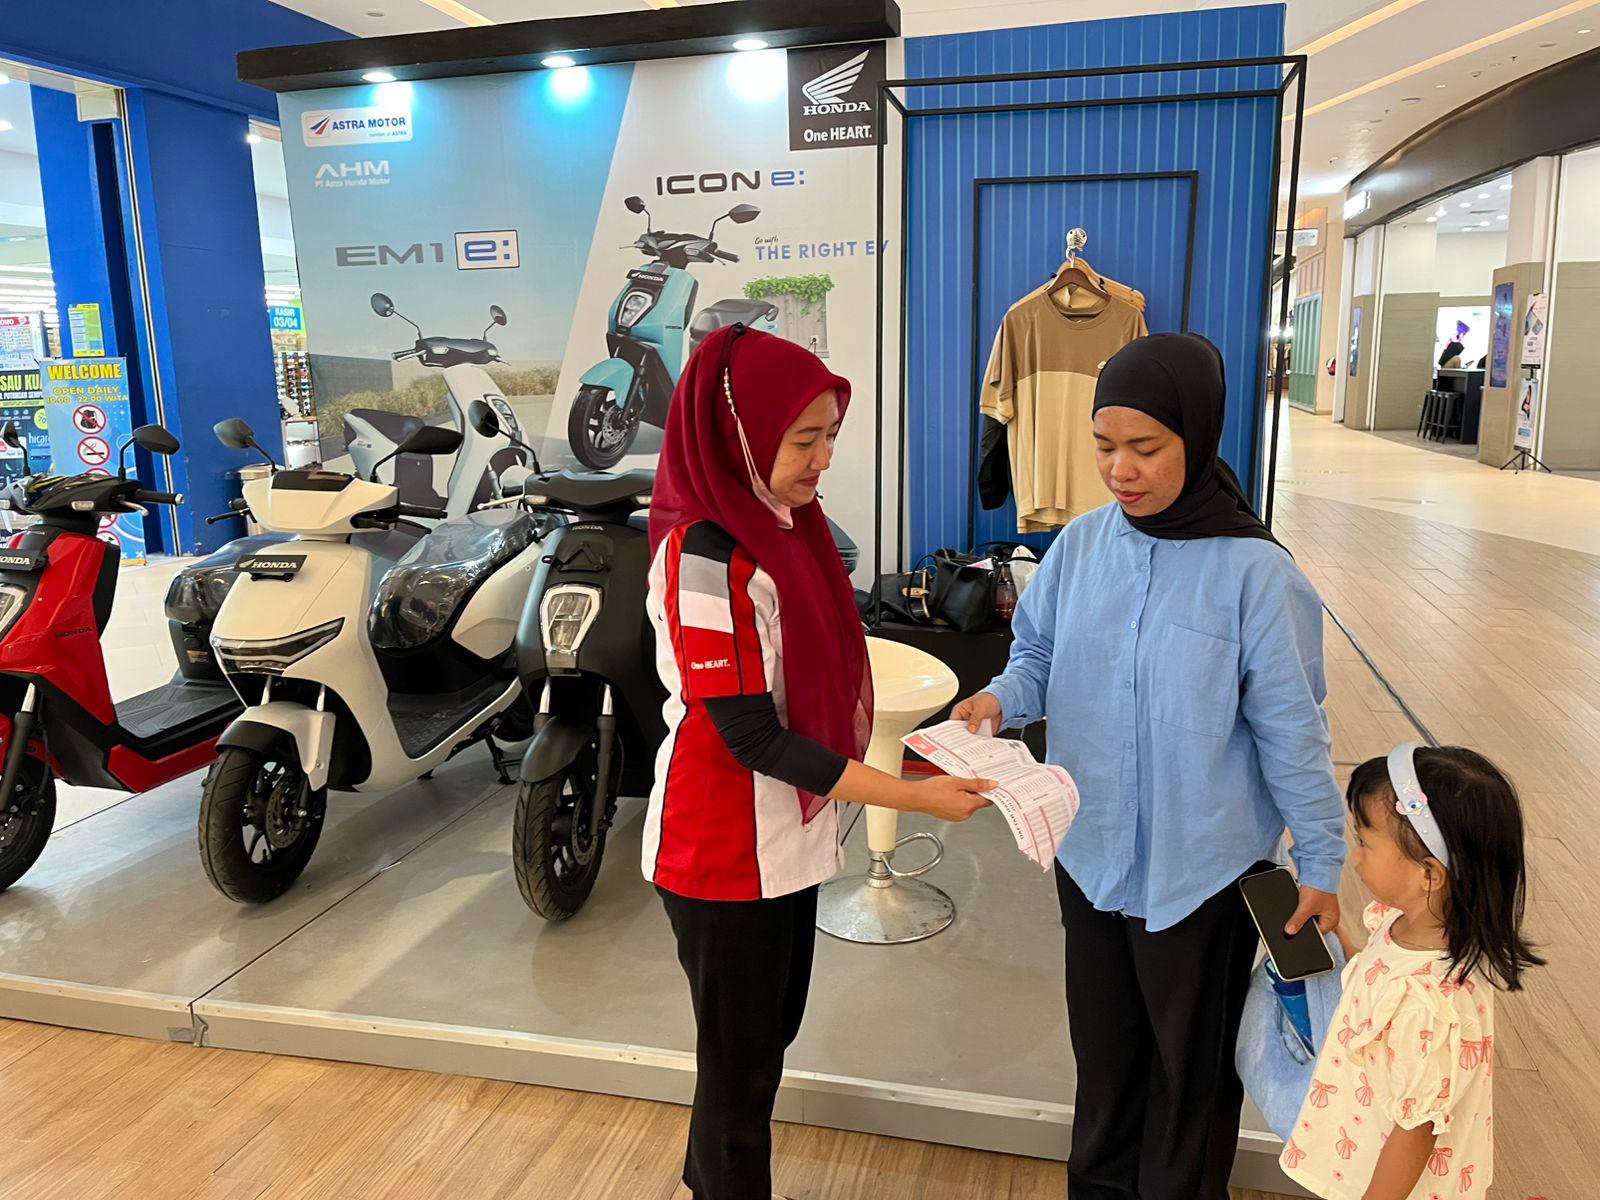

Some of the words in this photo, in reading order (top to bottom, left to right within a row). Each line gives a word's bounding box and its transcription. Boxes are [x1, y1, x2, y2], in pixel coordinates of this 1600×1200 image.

[803, 101, 871, 116] HONDA
[332, 120, 365, 130] ASTRA
[368, 117, 406, 128] MOTOR
[804, 128, 828, 142] One
[830, 125, 872, 141] HEART.
[315, 160, 390, 178] AHM
[369, 177, 390, 185] Motor
[656, 170, 760, 196] ICON
[771, 170, 805, 186] e:
[755, 237, 763, 245] Go
[764, 235, 779, 244] with
[335, 243, 444, 267] EM1
[464, 239, 510, 262] e:
[755, 245, 791, 260] THE
[799, 241, 857, 259] RIGHT
[638, 274, 664, 282] HONDA
[275, 307, 295, 317] KASIR
[273, 317, 298, 328] 03/04
[47, 364, 122, 380] WELCOME
[25, 374, 42, 390] KU
[53, 387, 85, 395] OPEN
[88, 386, 119, 394] DAILY
[0, 555, 30, 565] ONDA
[251, 561, 297, 569] HONDA
[55, 626, 92, 638] HONDA
[691, 661, 704, 670] One
